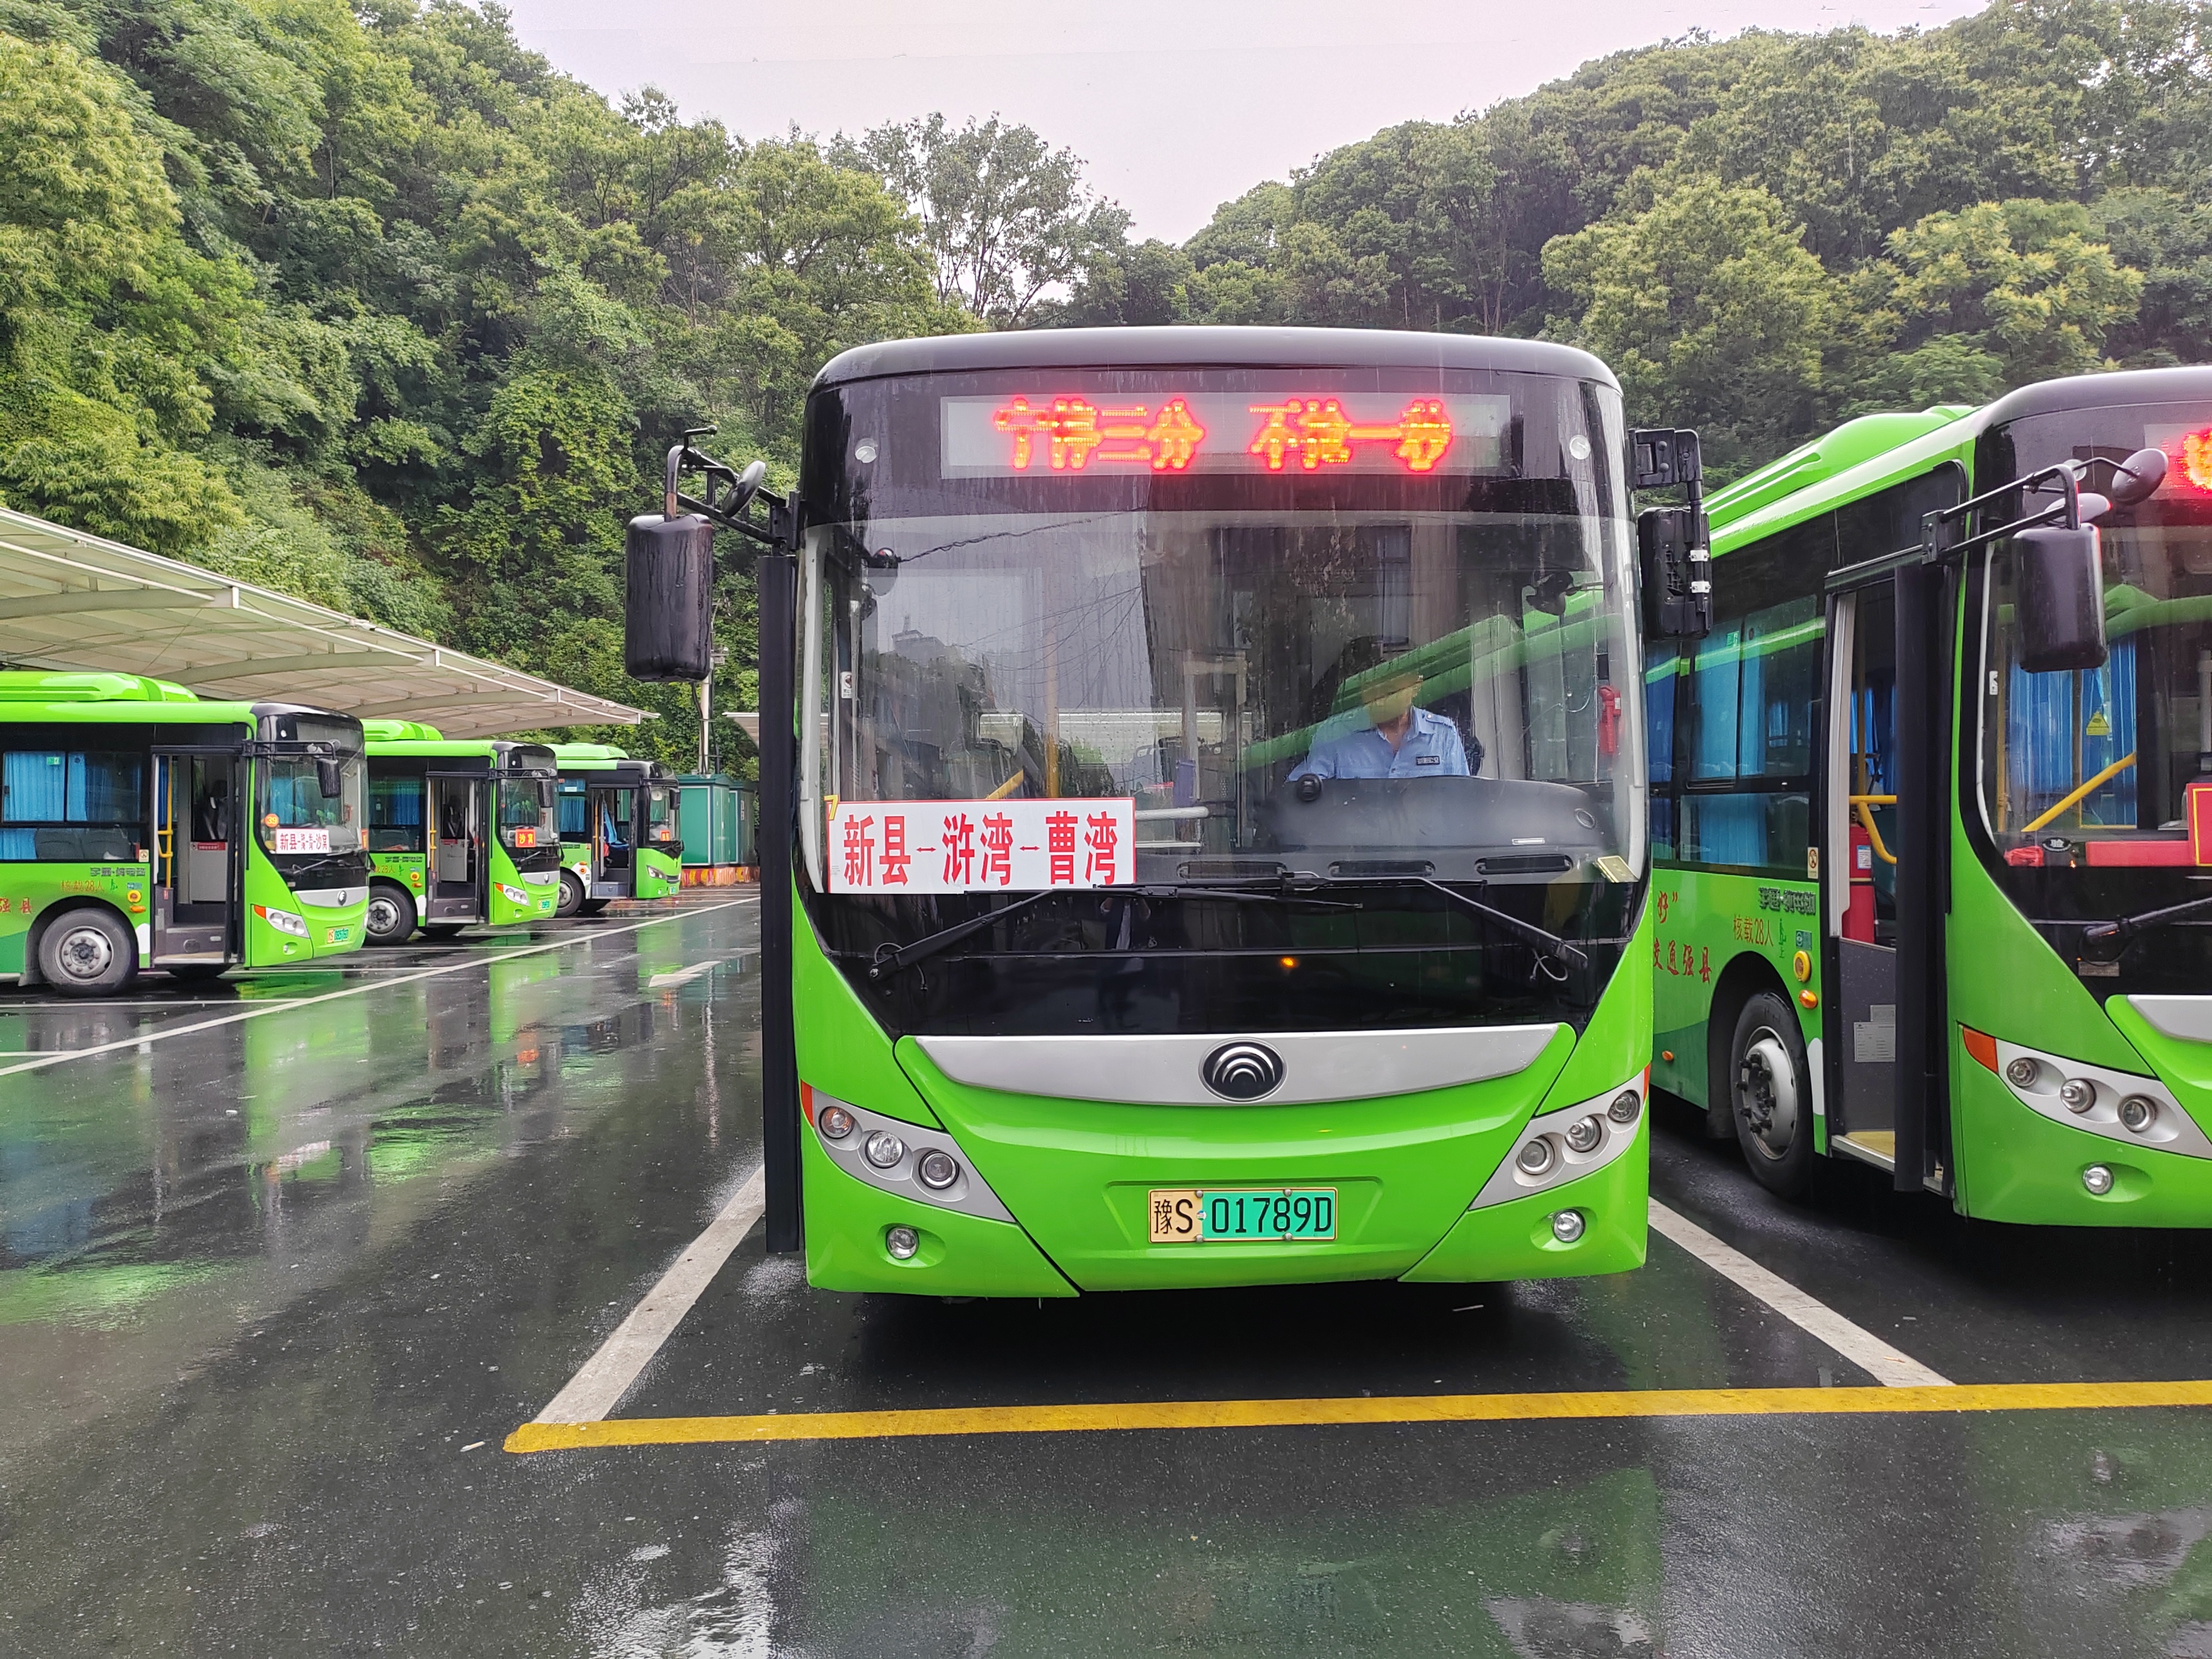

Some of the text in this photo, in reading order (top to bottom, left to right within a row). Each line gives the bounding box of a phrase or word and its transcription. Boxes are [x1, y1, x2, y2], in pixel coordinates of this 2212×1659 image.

[824, 795, 839, 820] 7
[1734, 915, 1773, 947] 核载28人
